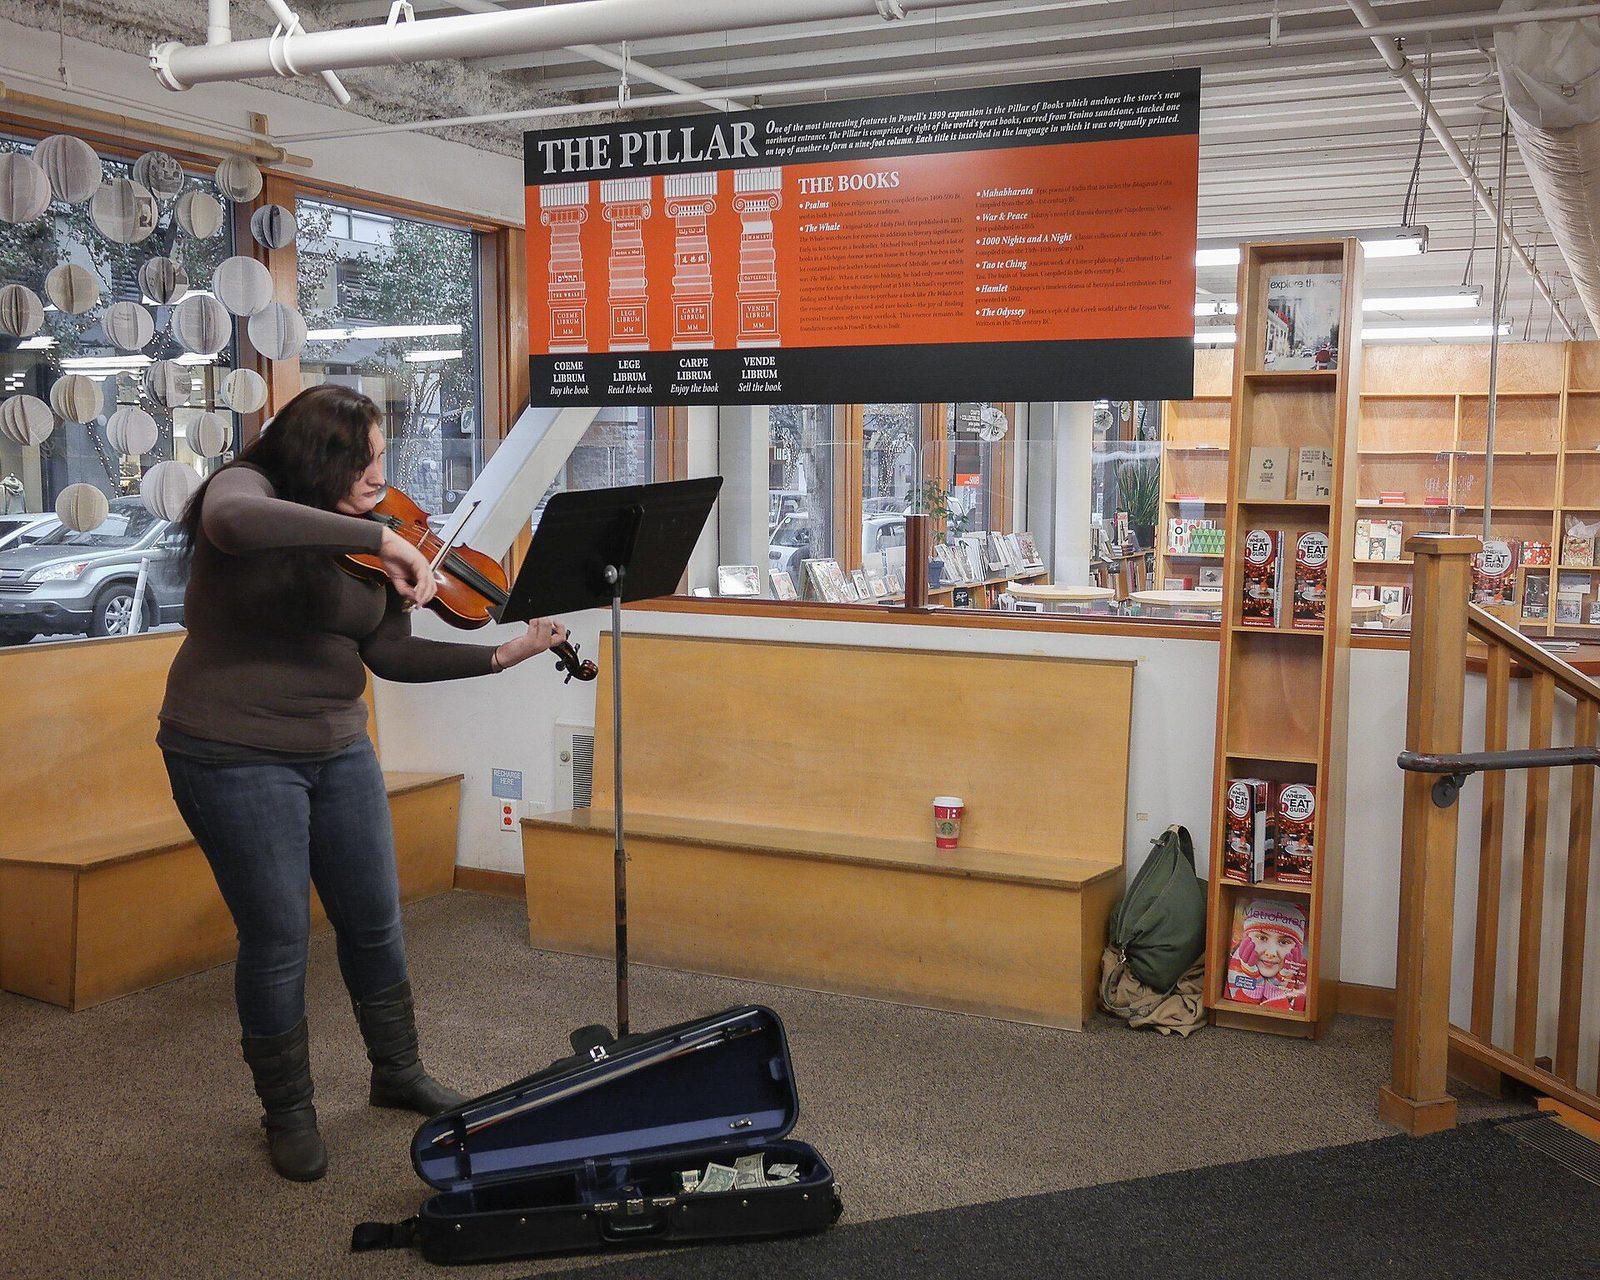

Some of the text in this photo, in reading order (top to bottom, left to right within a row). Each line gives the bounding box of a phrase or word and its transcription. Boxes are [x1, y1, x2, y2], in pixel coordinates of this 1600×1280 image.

[766, 120, 782, 133] One
[782, 123, 792, 134] of
[793, 122, 803, 130] the
[805, 121, 821, 129] most
[822, 118, 858, 130] interesting
[858, 115, 887, 127] features
[888, 114, 897, 122] in
[898, 112, 926, 121] Powell's
[928, 110, 946, 118] 1999
[947, 107, 984, 119] expansion
[986, 106, 992, 114] is
[994, 104, 1006, 113] the
[1008, 103, 1030, 112] Pillar
[1030, 102, 1040, 112] of
[1042, 100, 1064, 109] Books
[1066, 98, 1088, 107] which
[1090, 95, 1121, 104] anchors
[1123, 93, 1135, 102] the
[1138, 92, 1162, 100] store's
[765, 135, 796, 144] northwest
[797, 132, 827, 142] entrance.
[842, 129, 861, 138] Pillar
[862, 128, 868, 137] is
[869, 126, 903, 138] comprised
[903, 124, 913, 136] of
[913, 124, 930, 134] eight
[930, 122, 940, 133] of
[940, 121, 952, 130] the
[952, 119, 978, 128] world's
[979, 118, 998, 128] great
[999, 116, 1022, 127] books,
[1023, 114, 1047, 122] carved
[1047, 112, 1066, 123] from
[1067, 110, 1093, 118] Tenino
[1094, 106, 1134, 119] sandstone,
[1136, 103, 1165, 113] stacked
[775, 146, 785, 158] top
[785, 146, 794, 157] of
[795, 144, 821, 153] another
[822, 143, 829, 151] to
[828, 142, 847, 153] form
[854, 139, 885, 150] nine-foot
[886, 136, 914, 145] column.
[915, 135, 933, 143] Each
[934, 133, 949, 141] title
[950, 132, 957, 140] is
[958, 130, 991, 139] inscribed
[992, 128, 1000, 137] in
[1002, 127, 1014, 136] the
[1015, 125, 1048, 137] language
[1050, 124, 1058, 132] in
[1060, 122, 1082, 131] which
[1084, 121, 1090, 129] it
[1108, 117, 1146, 129] originally
[1148, 114, 1180, 126] printed.
[538, 122, 758, 174] THE PILLAR
[798, 172, 900, 194] THE BOOKS
[982, 188, 1034, 198] Mahabharata
[804, 201, 830, 210] Psalms
[982, 213, 998, 221] War
[805, 224, 818, 232] The
[819, 222, 841, 232] Whale
[982, 237, 1000, 246] 1000
[1001, 236, 1025, 249] Nights
[1027, 234, 1041, 243] and
[1042, 234, 1049, 243] A
[1050, 233, 1072, 247] Night
[1005, 260, 1027, 270] Ching
[981, 284, 1008, 293] Hamlet
[982, 308, 995, 316] The
[996, 308, 1026, 318] Odyssey
[554, 362, 583, 371] COEME
[618, 360, 640, 369] LEGE
[680, 358, 708, 368] CARPE
[744, 357, 776, 366] VENDE
[553, 374, 585, 383] LIBRUM
[613, 372, 646, 382] LIBRUM
[677, 370, 712, 380] LIBRUM
[742, 370, 778, 379] LIBRUM
[550, 385, 589, 397] Buy the book
[608, 384, 653, 394] Read the book
[670, 382, 719, 396] Enjoy the book
[738, 382, 782, 392] Sell the book
[1252, 543, 1269, 552] EAT
[1486, 555, 1508, 563] EAT
[1235, 796, 1248, 805] EAT
[1290, 800, 1311, 808] EAT
[1242, 906, 1307, 926] MetroParen
